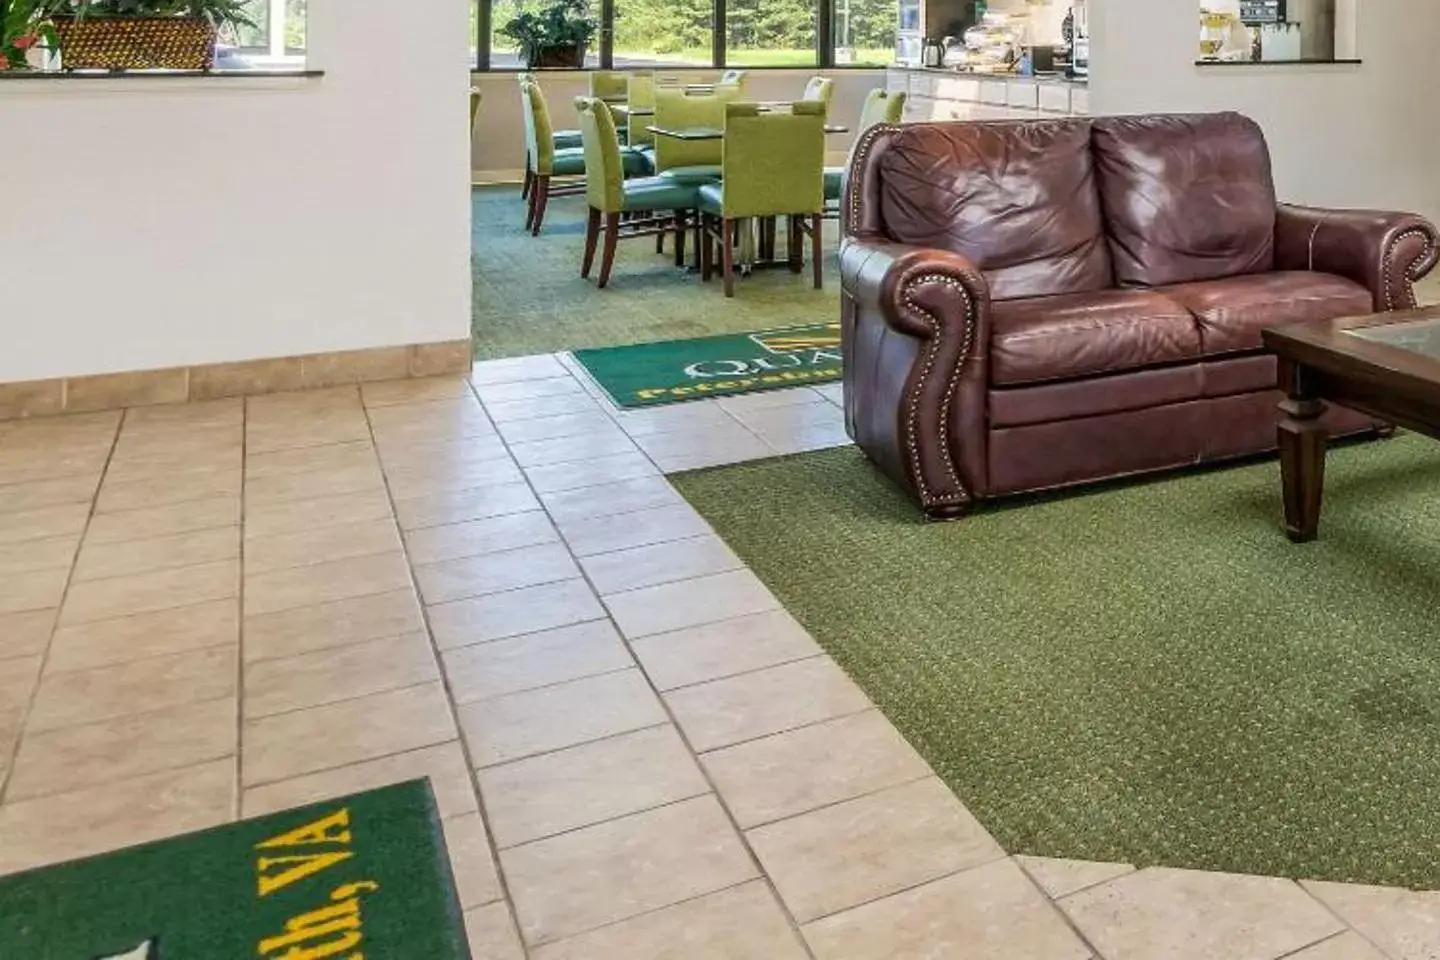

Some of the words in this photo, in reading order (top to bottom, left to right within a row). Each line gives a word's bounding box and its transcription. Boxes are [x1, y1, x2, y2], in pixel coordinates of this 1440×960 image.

[683, 350, 843, 379] QUA
[254, 808, 354, 896] VA
[258, 881, 379, 960] th,
